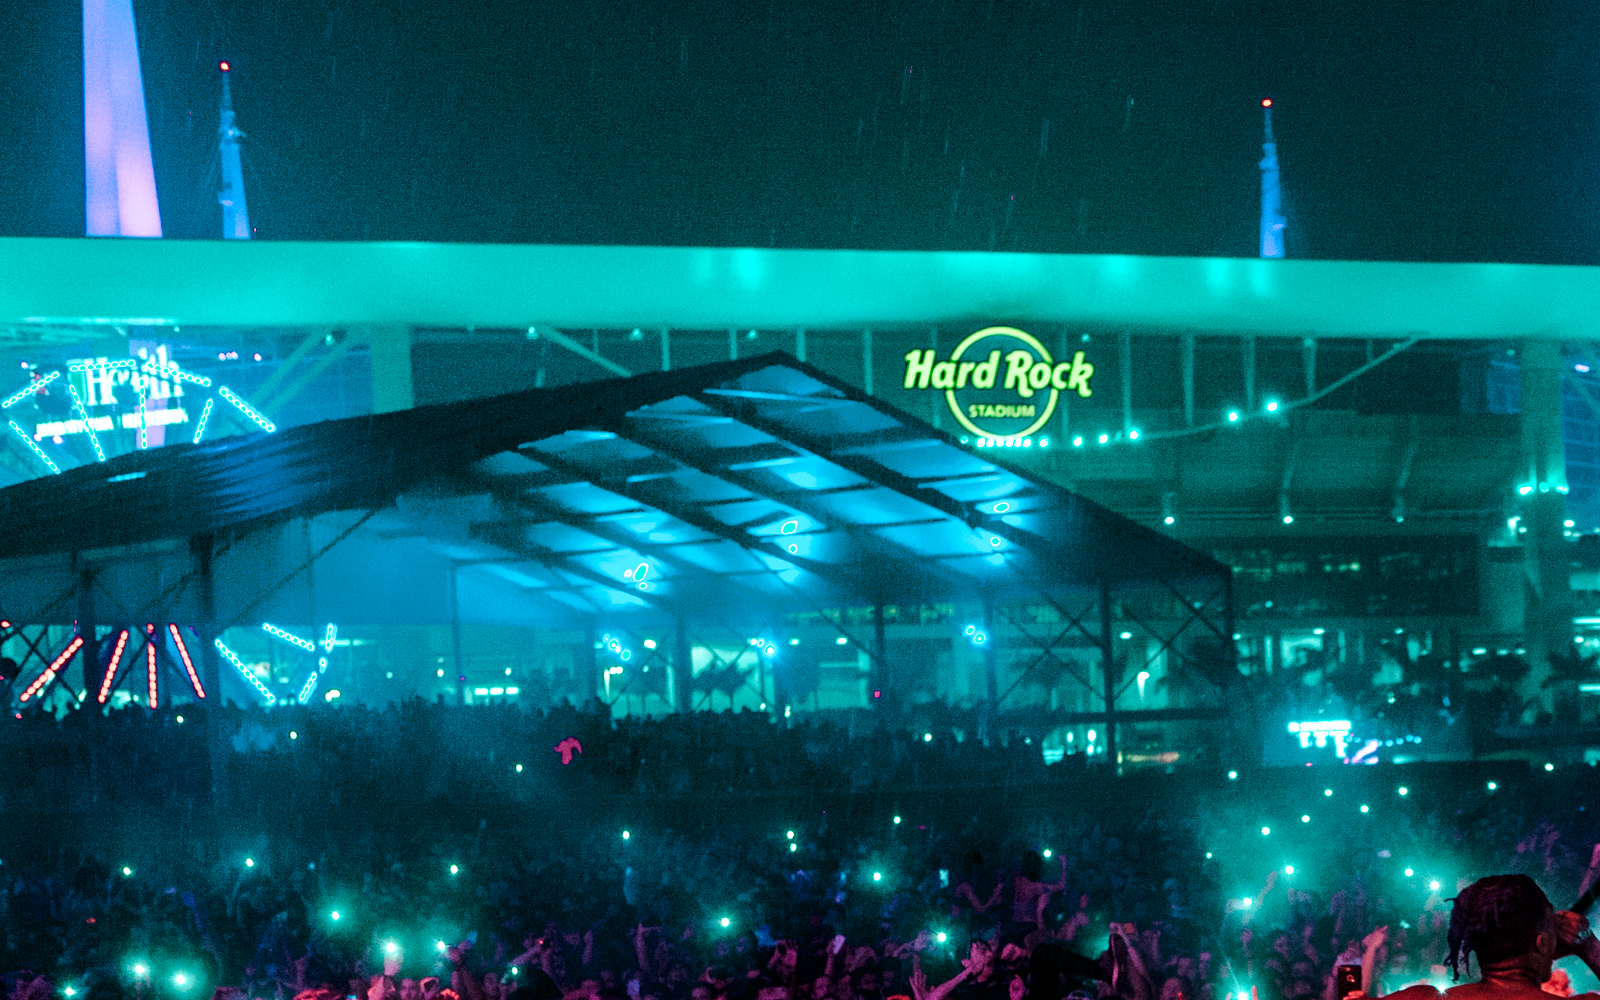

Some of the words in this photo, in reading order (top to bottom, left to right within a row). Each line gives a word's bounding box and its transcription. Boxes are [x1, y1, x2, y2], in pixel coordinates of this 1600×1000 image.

[903, 349, 1001, 390] Hard
[1003, 349, 1095, 399] Rock
[968, 404, 1036, 419] STADIUM
